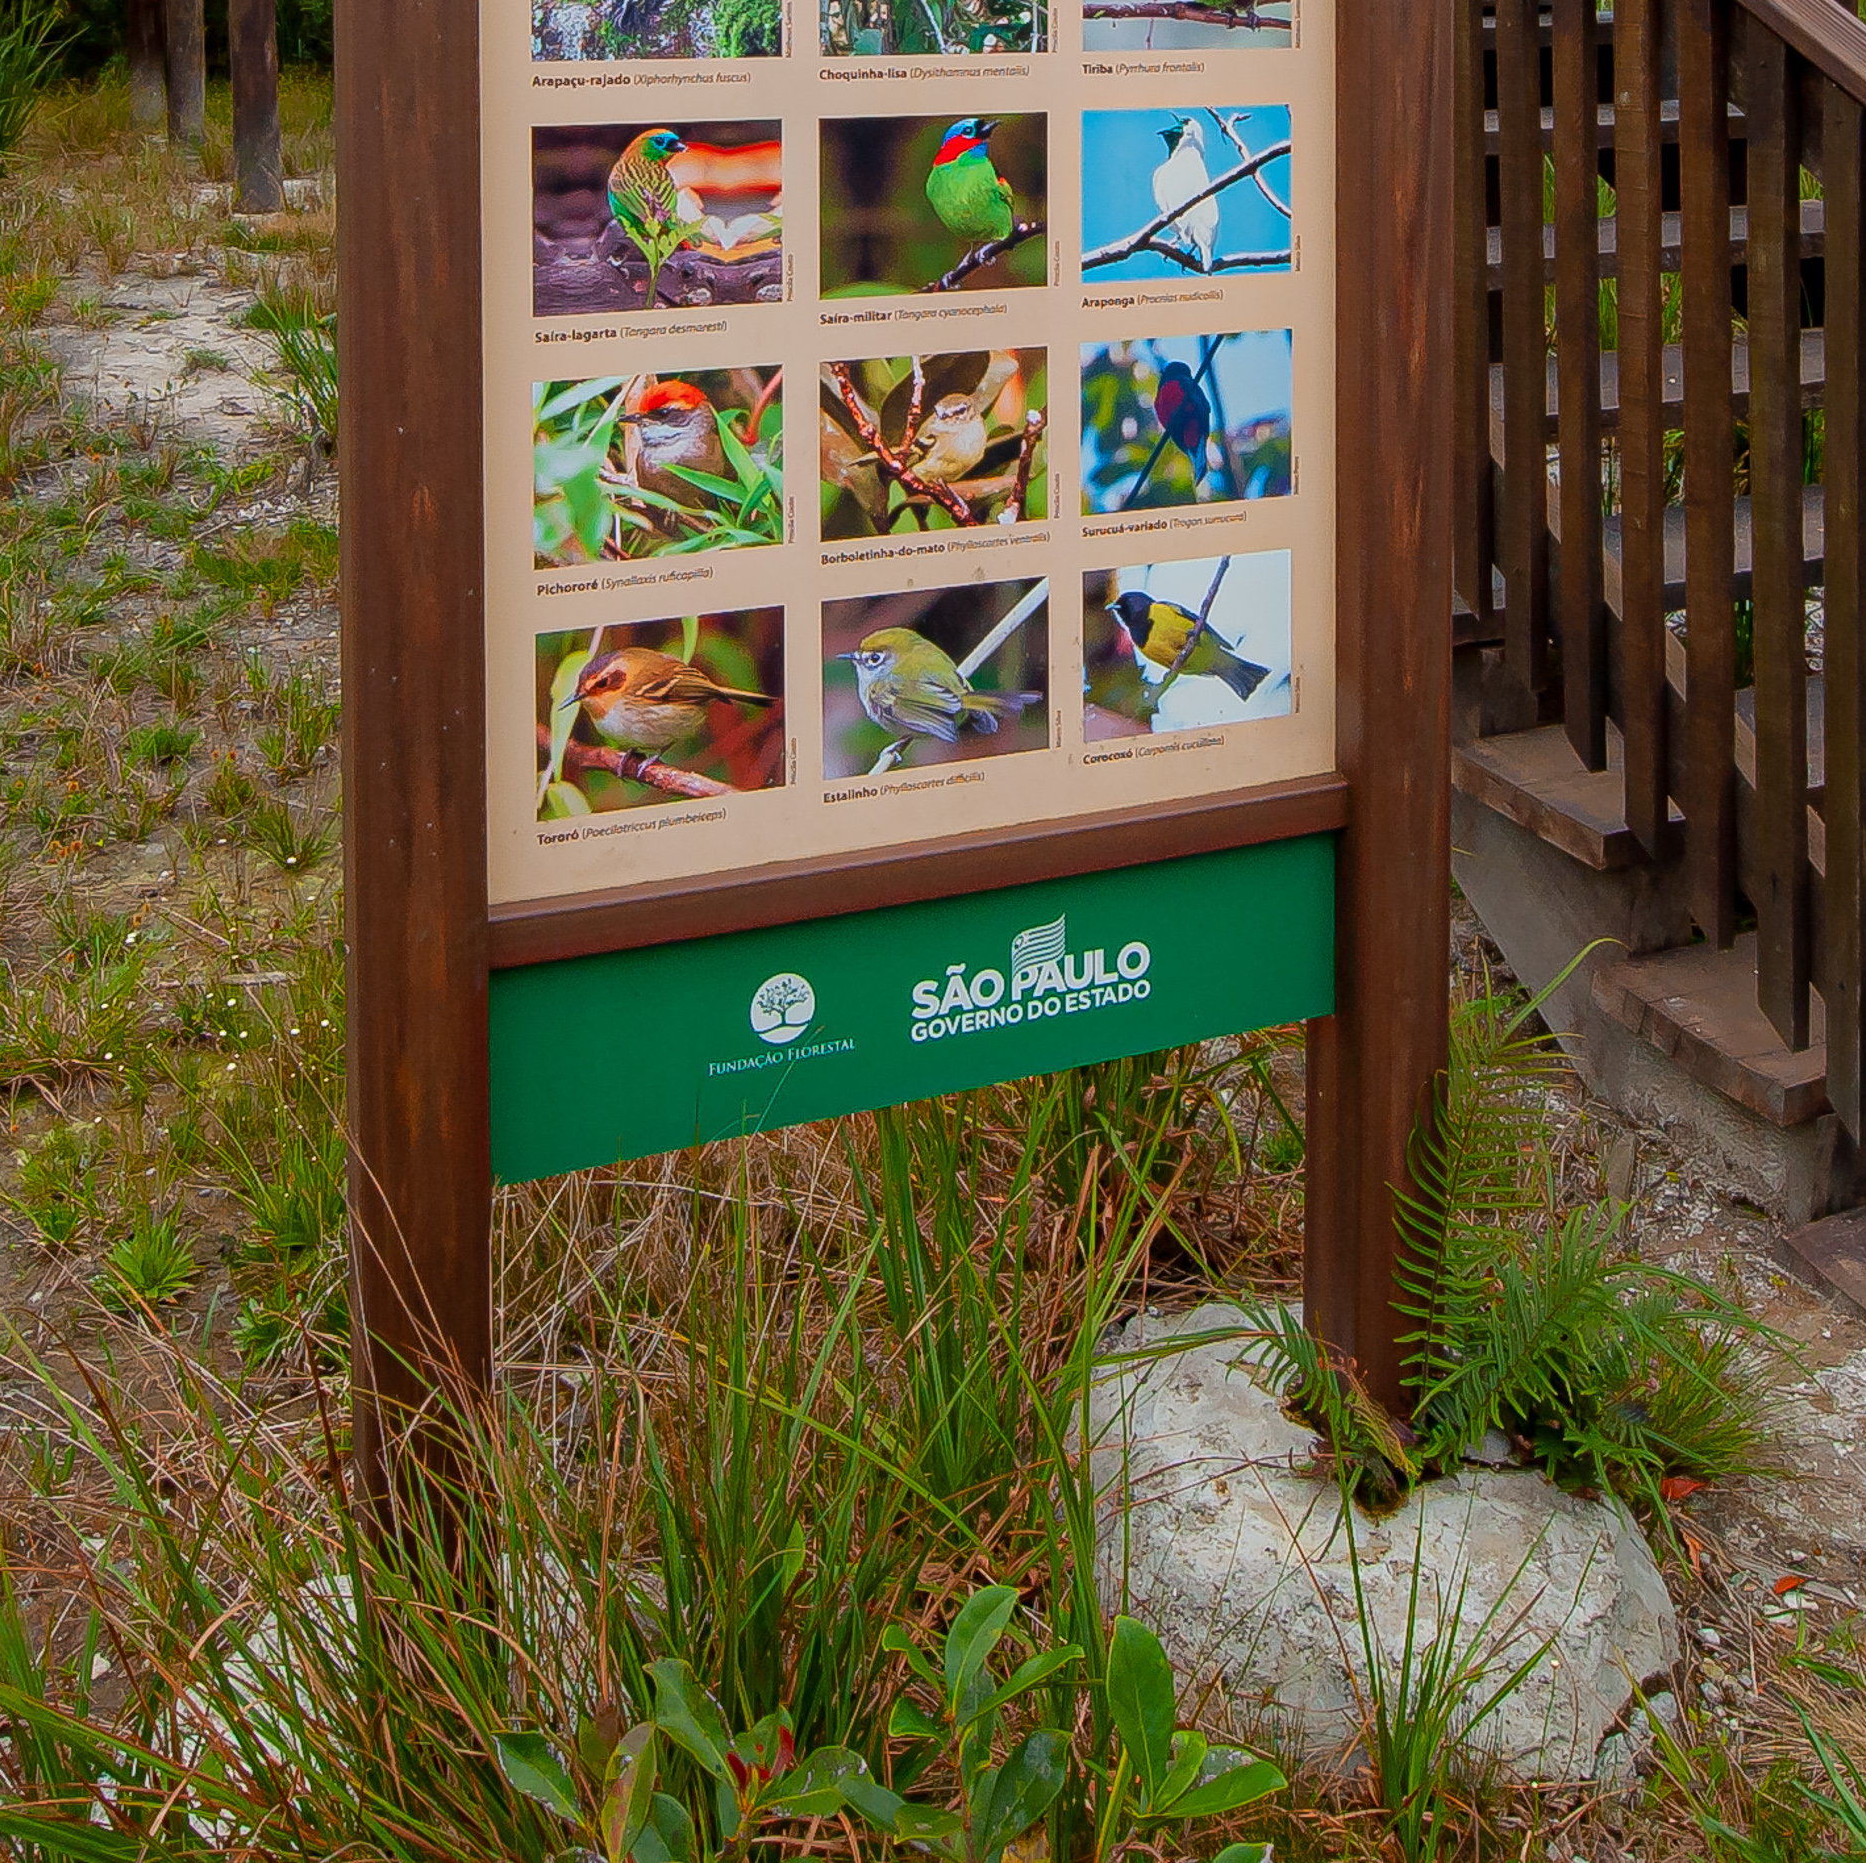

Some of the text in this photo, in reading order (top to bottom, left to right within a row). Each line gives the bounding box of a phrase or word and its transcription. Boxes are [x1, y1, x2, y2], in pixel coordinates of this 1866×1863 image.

[819, 67, 908, 83] Choquinha-lisa
[1081, 62, 1114, 75] Tiriba
[531, 73, 631, 90] Arapaçu-rajado
[1081, 296, 1135, 310] Araponga
[819, 310, 893, 325] Saíra-militar
[535, 328, 618, 344] Saíra-lagarta
[1081, 519, 1168, 538] Surucuá-variado
[820, 544, 946, 566] Borboletinha-do-mato
[536, 578, 599, 597] Pichororé
[1082, 747, 1134, 765] Corocoxó
[823, 786, 879, 804] Estalinho
[536, 828, 580, 848] Tororó
[911, 940, 1151, 1020] SÃO PAULO
[911, 979, 1151, 1042] GOVERNO DO ESTADO
[709, 1037, 855, 1077] FUNDAÇÃO FLORESTAL
